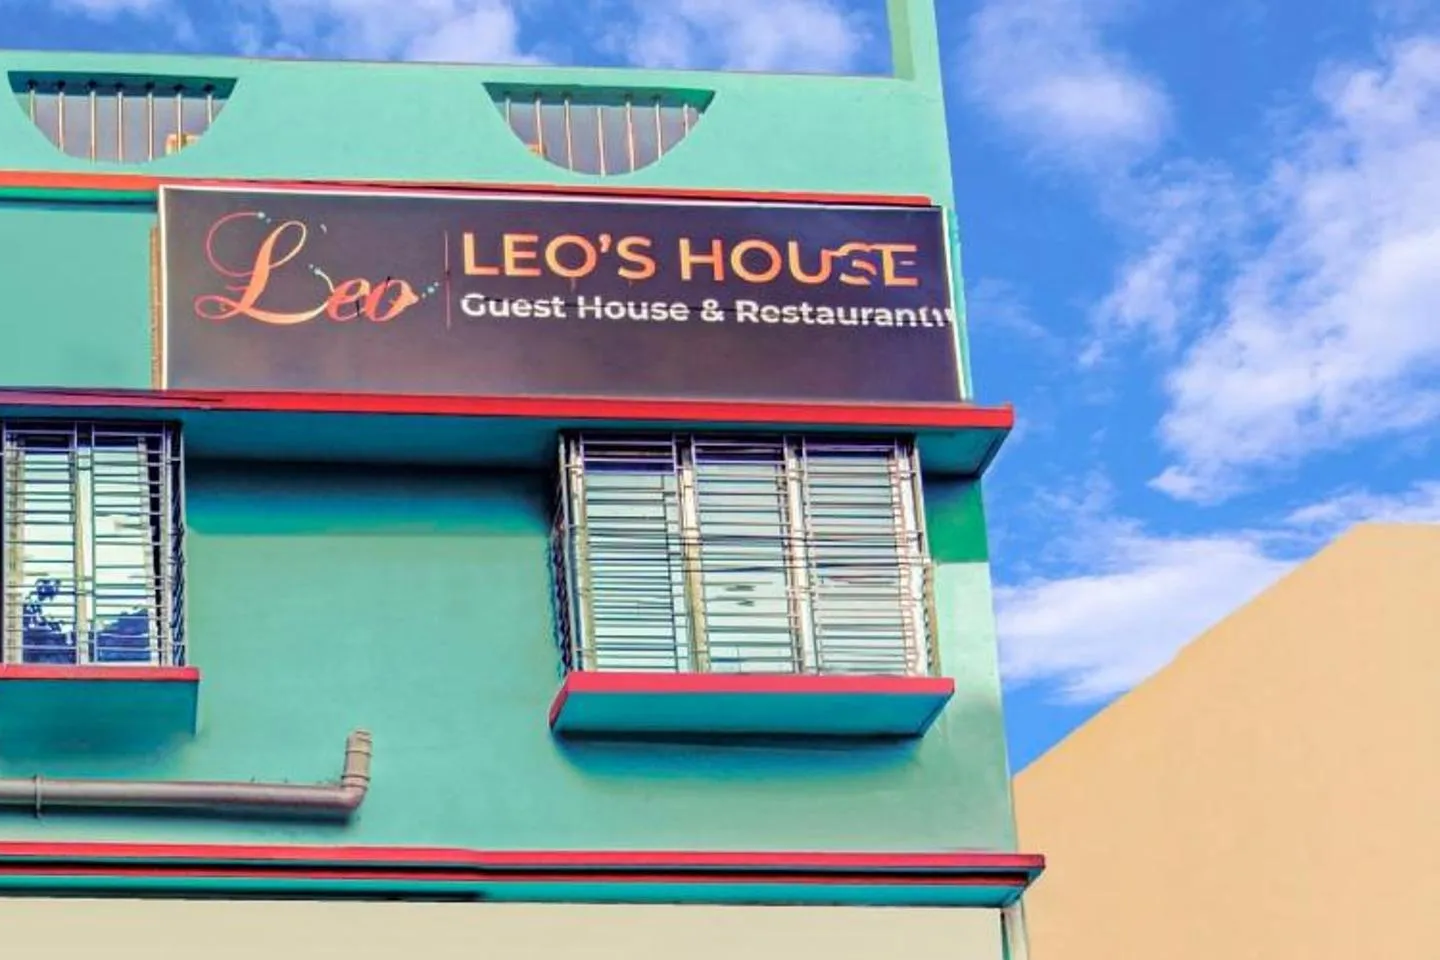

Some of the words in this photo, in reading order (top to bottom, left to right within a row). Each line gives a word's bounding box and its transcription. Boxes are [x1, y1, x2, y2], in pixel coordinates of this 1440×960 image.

[193, 211, 420, 325] Leo
[463, 232, 656, 280] LEO'S
[679, 237, 918, 287] HOUSE
[461, 293, 566, 318] Guest
[577, 295, 690, 321] House
[700, 299, 725, 322] &
